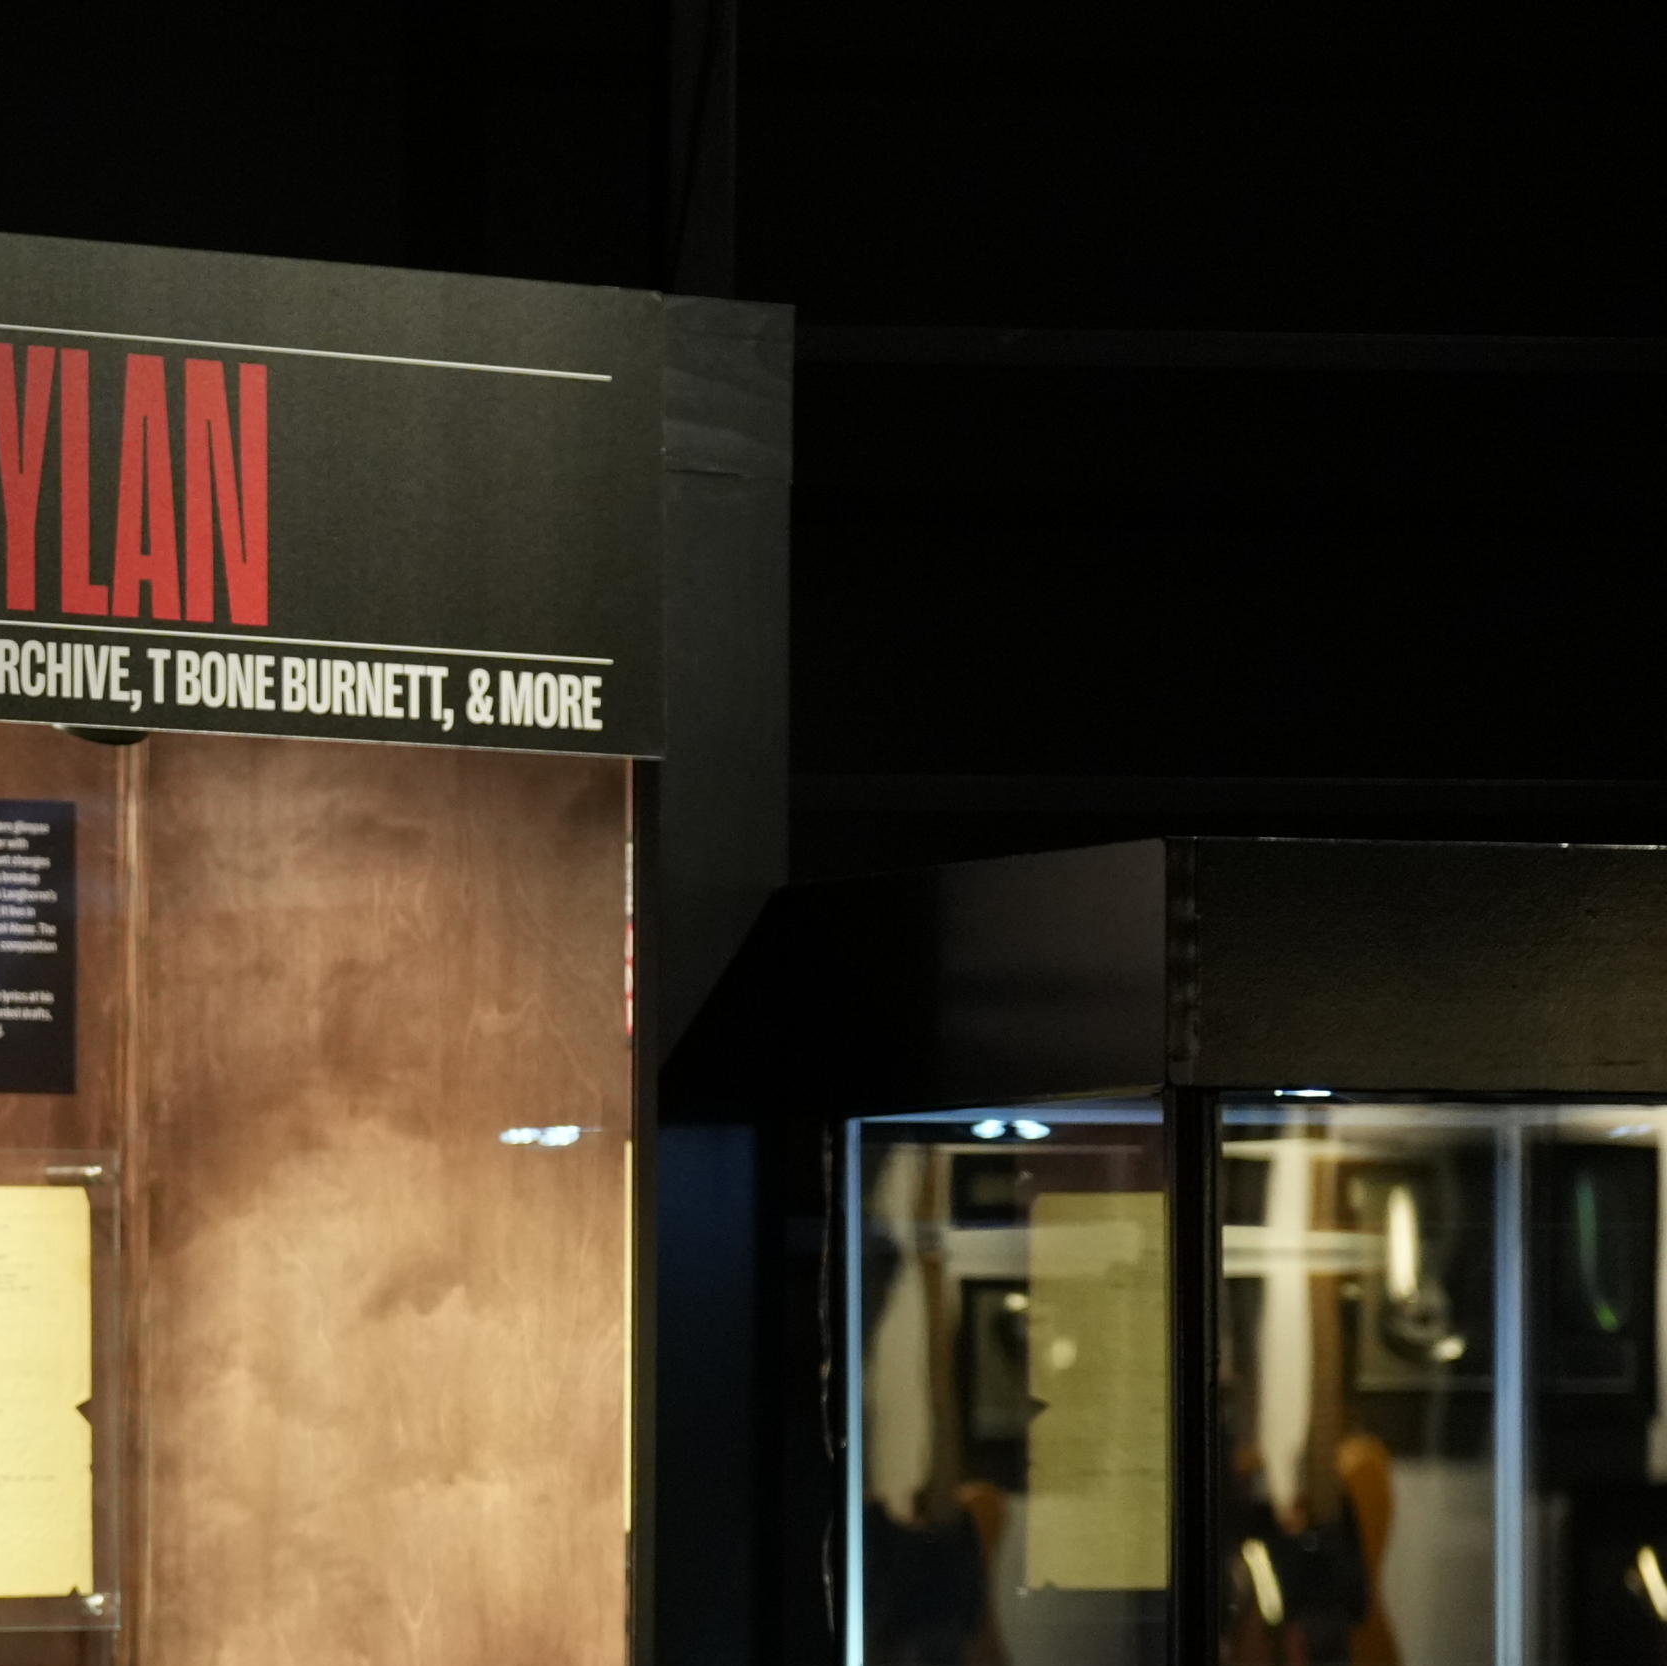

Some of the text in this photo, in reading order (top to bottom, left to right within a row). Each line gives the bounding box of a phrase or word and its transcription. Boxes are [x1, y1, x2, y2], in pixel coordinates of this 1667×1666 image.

[147, 648, 171, 704] T
[177, 649, 275, 710] BONE
[282, 656, 454, 732] BURNETT,
[466, 668, 494, 725] &
[499, 670, 603, 731] MORE
